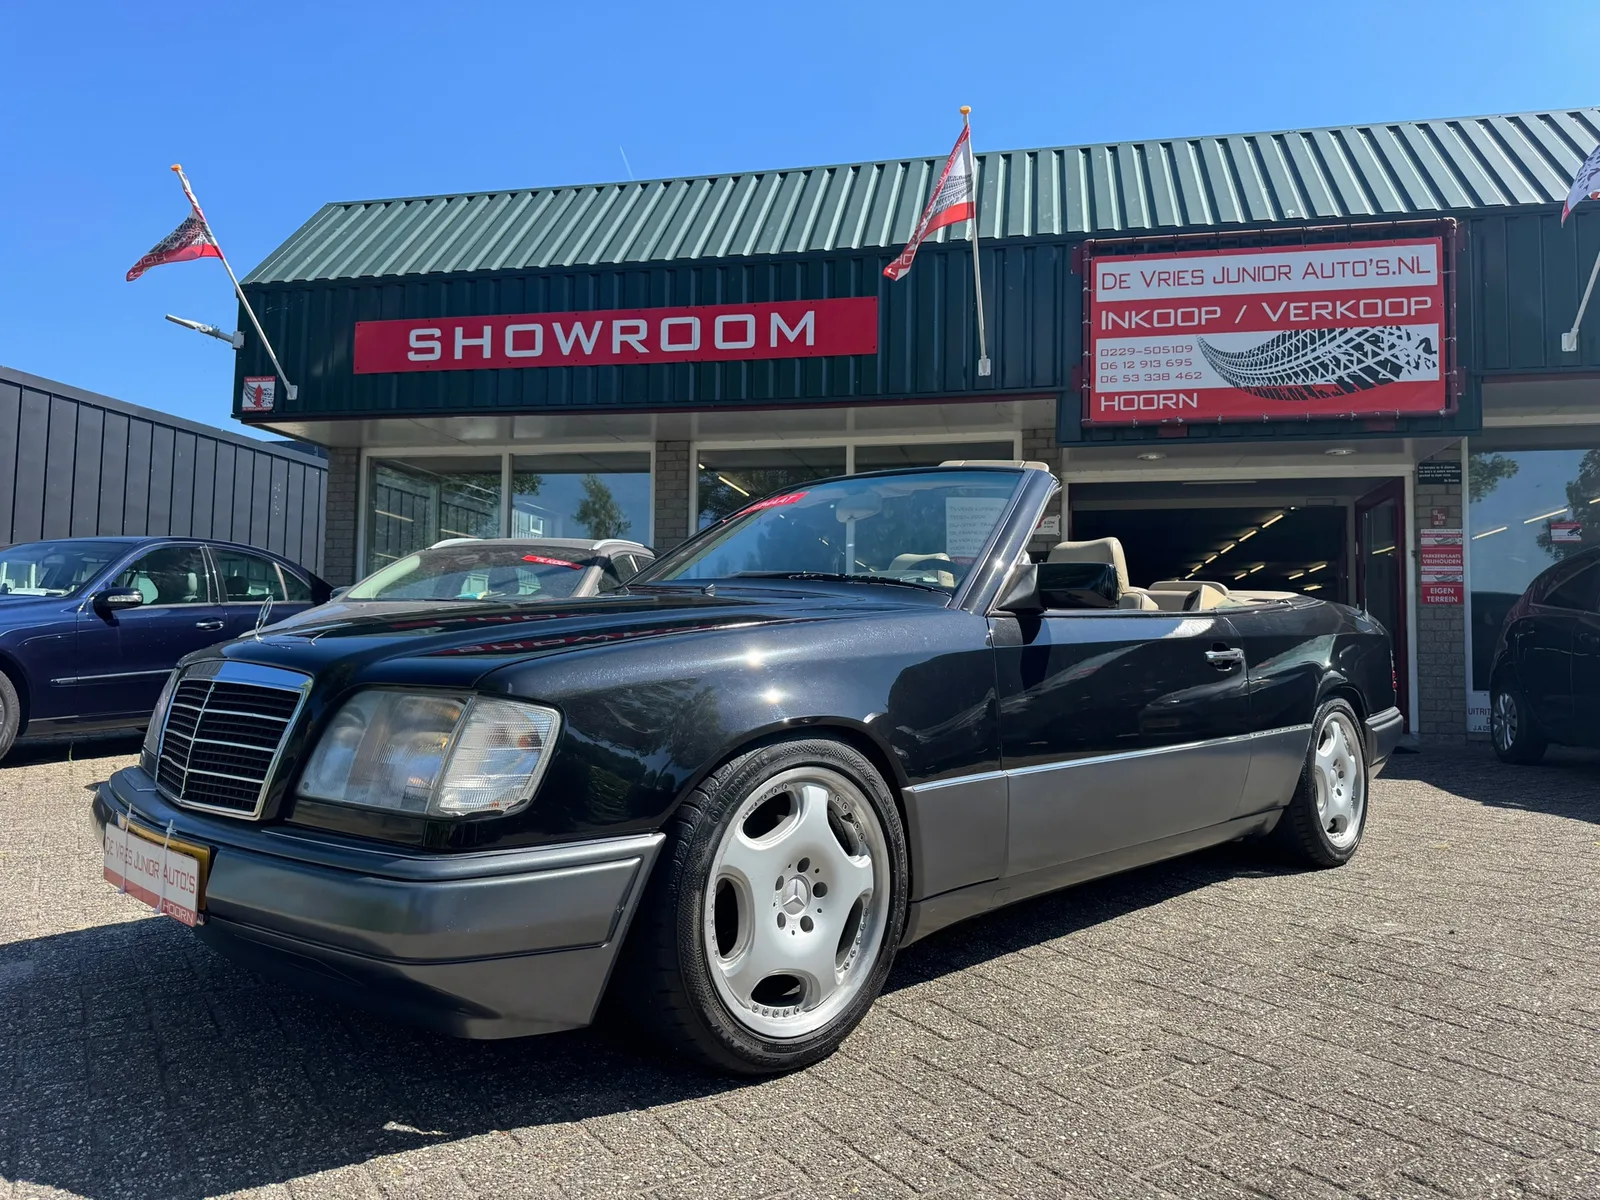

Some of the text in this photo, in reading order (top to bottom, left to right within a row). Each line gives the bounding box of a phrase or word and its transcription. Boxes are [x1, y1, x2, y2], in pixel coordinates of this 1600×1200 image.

[1101, 256, 1431, 291] DE VRIES JUNIOR AUTO'S.NL
[1101, 297, 1432, 330] INKOOP / VERKOOP
[408, 310, 815, 362] SHOWROOM
[1100, 344, 1193, 357] 0229-505109
[1100, 358, 1192, 370] 06 12 913 695
[1100, 371, 1202, 384] 06 53 338 462
[1100, 392, 1198, 412] HOORN
[105, 836, 114, 856] DE
[134, 851, 159, 879] JUNIOR
[163, 863, 196, 894] AUTO'S
[163, 901, 194, 924] HOORN
